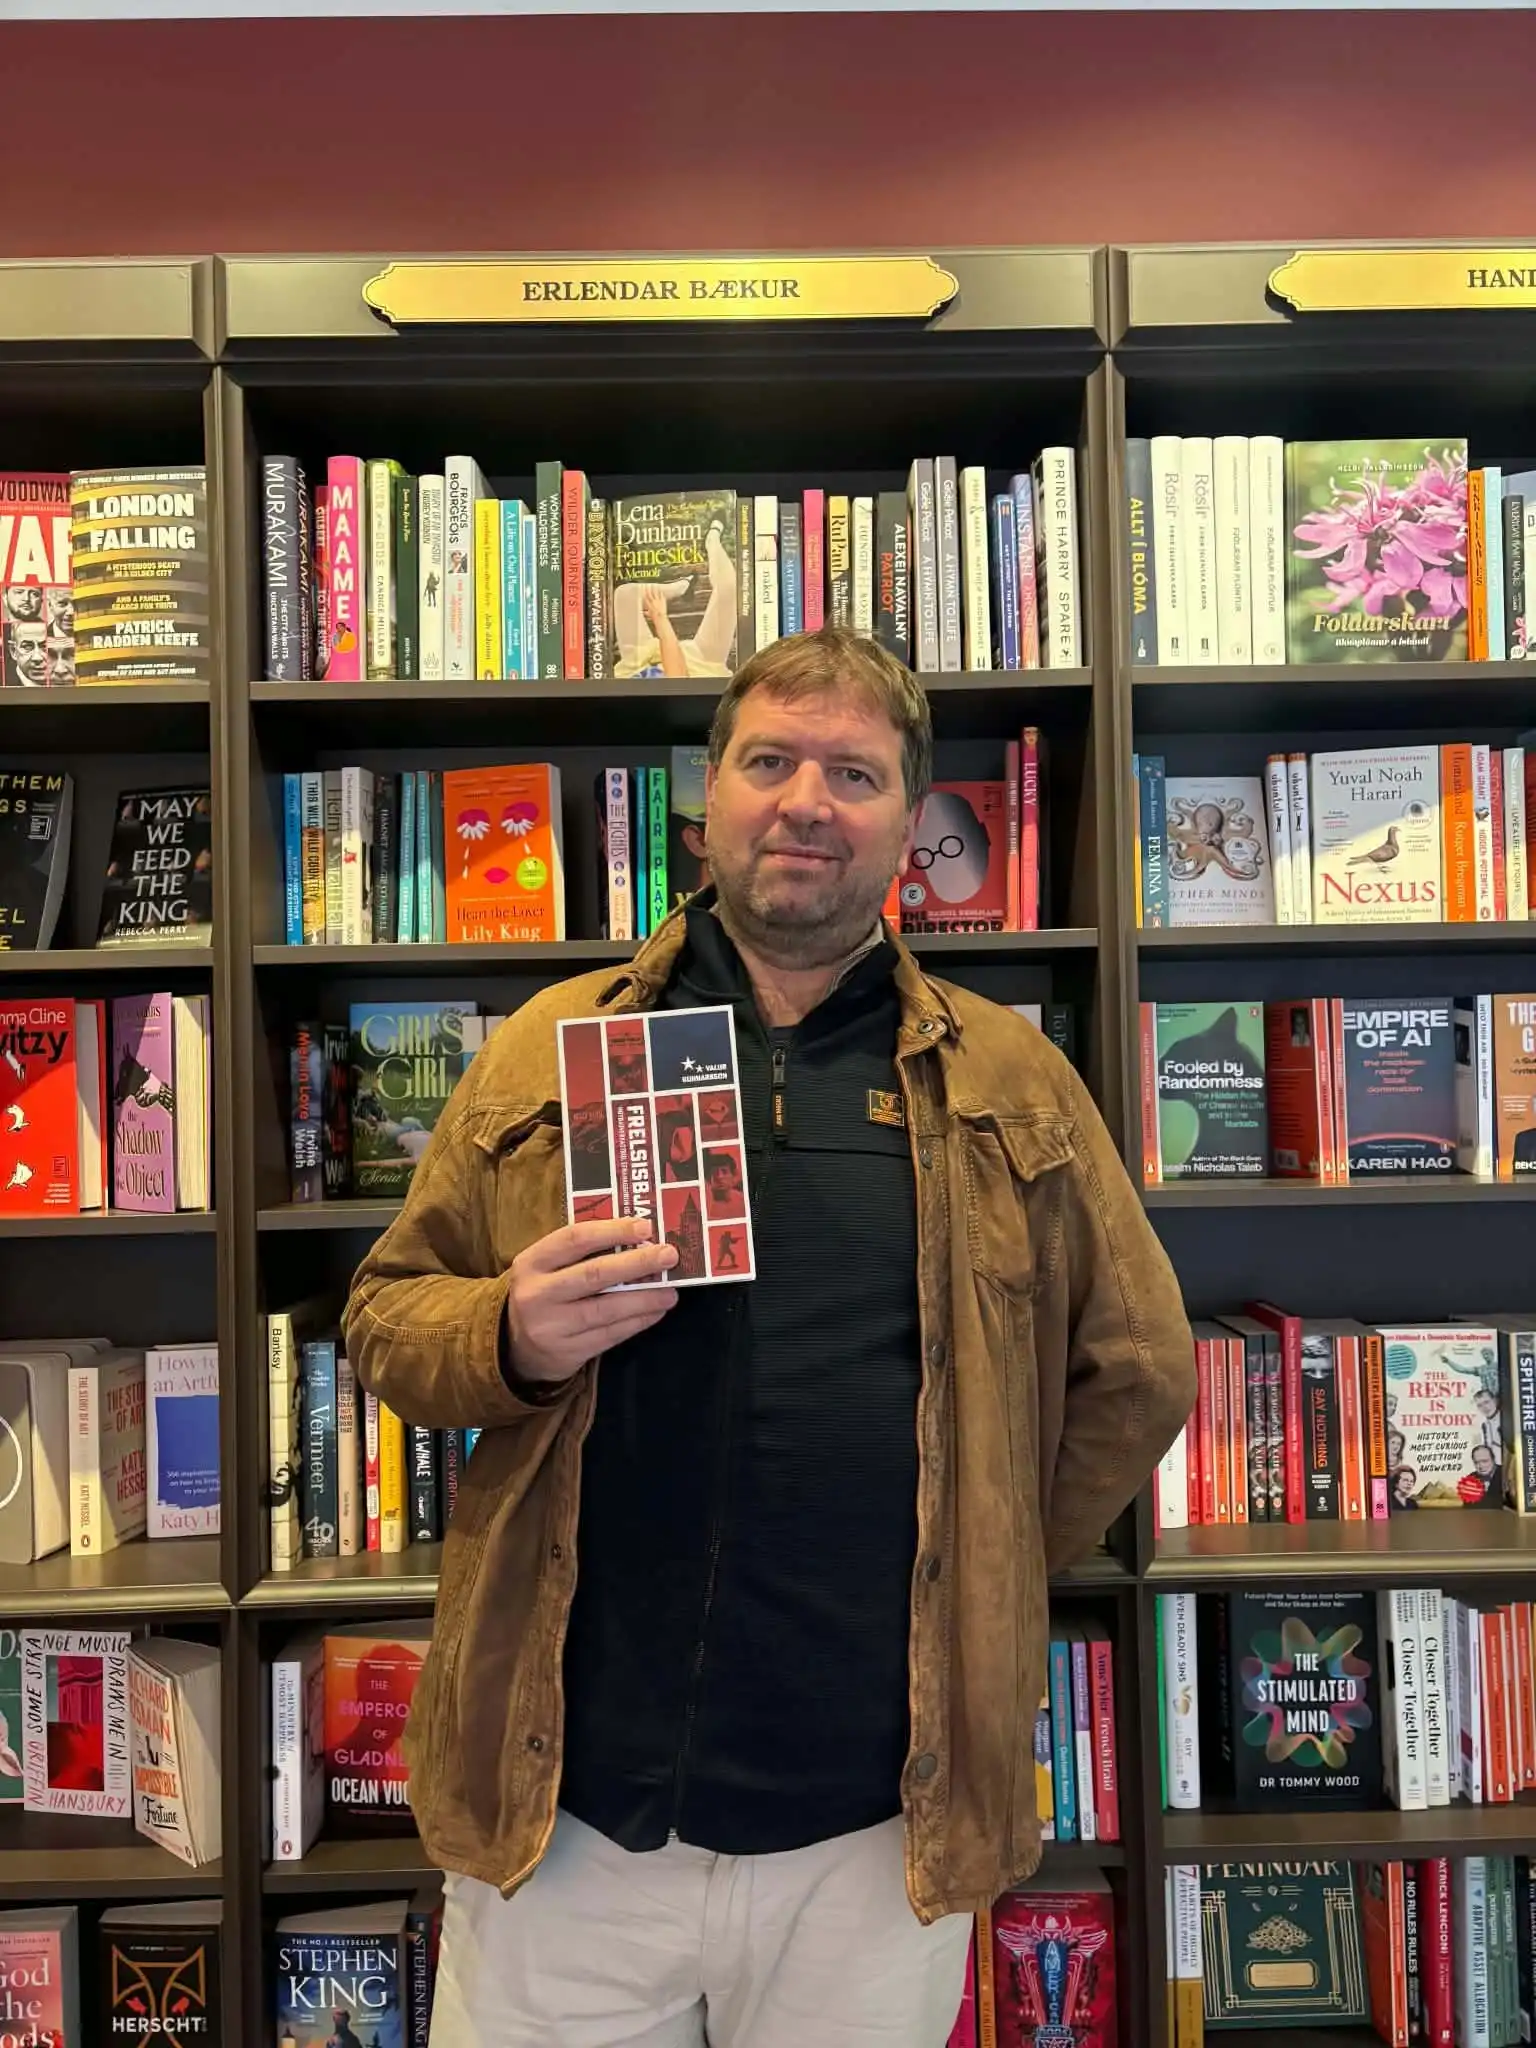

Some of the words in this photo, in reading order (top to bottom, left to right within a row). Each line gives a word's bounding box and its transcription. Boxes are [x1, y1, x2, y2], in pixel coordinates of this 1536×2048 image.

[522, 281, 678, 302] ERLENDAR
[689, 279, 800, 299] BÆKUR
[1055, 459, 1066, 520] PRINCE
[1165, 472, 1179, 518] Rósir
[1195, 474, 1209, 519] Rósir
[89, 494, 194, 520] LONDON
[449, 473, 459, 544] BOURGEOIS
[459, 487, 468, 529] FRANCIS
[550, 494, 559, 534] WOMAN
[568, 488, 578, 537] WILDER
[616, 501, 665, 524] Lena
[1130, 497, 1144, 537] ALLT
[266, 463, 287, 587] MURAKAMI
[298, 467, 310, 593] MURAKAMI
[506, 521, 516, 540] Life
[539, 500, 548, 566] WILDERNESS
[616, 521, 704, 545] Dunham
[89, 526, 196, 552] FALLING
[551, 537, 559, 548] IN
[588, 512, 604, 581] BRYSON
[894, 523, 906, 573] ALEXEI
[333, 486, 353, 619] MAAME
[551, 551, 560, 571] THE
[616, 543, 705, 567] Famesick
[922, 555, 931, 564] A
[945, 553, 953, 562] A
[1057, 526, 1069, 581] HARRY
[568, 542, 578, 607] JOURNEYS
[763, 571, 772, 604] naked
[881, 552, 894, 614] PATRIOT
[922, 566, 934, 598] HYMN
[945, 564, 955, 598] HYMN
[1132, 553, 1149, 614] BLÓMA
[592, 599, 602, 632] WALK
[895, 575, 907, 641] NAVALNY
[923, 600, 934, 617] TO
[946, 600, 955, 617] TO
[1059, 592, 1071, 643] SPARE
[115, 619, 176, 634] PATRICK
[924, 621, 936, 643] LIFE
[947, 619, 956, 643] LIFE
[1313, 613, 1450, 633] Foldarskart
[93, 633, 152, 649] RADDEN
[154, 632, 199, 647] KEEFE
[1476, 751, 1484, 772] ADAM
[1024, 762, 1036, 806] LUCKY
[1329, 766, 1372, 785] Yuval
[1379, 765, 1422, 782] Noah
[1476, 775, 1485, 800] GRANT
[307, 781, 319, 802] THIS
[1351, 787, 1402, 801] Harari
[139, 798, 199, 820] MAY
[653, 772, 663, 838] FAIR
[146, 822, 185, 845] WE
[1455, 821, 1467, 858] Rutger
[132, 848, 191, 871] FEED
[1148, 835, 1162, 895] FEMINA
[134, 874, 184, 896] THE
[653, 856, 664, 921] PLAY
[1321, 872, 1436, 905] Nexus
[1456, 860, 1468, 908] Bregman
[119, 900, 189, 924] KING
[457, 906, 488, 922] Heart
[492, 906, 509, 919] the
[461, 926, 493, 942] Lily
[500, 924, 542, 942] King
[29, 1008, 67, 1025] Cline
[1344, 1010, 1449, 1030] EMPIRE
[297, 1031, 311, 1064] Men
[361, 1012, 465, 1058] GIRL'S
[1356, 1030, 1397, 1048] OF
[1402, 1029, 1431, 1047] AI
[299, 1066, 311, 1082] in
[377, 1057, 453, 1100] GIRL
[1164, 1061, 1219, 1074] Fooled
[1223, 1061, 1244, 1076] by
[1159, 1075, 1264, 1090] Randomness
[299, 1086, 312, 1120] Love
[116, 1118, 164, 1156] Shadow
[295, 1128, 306, 1168] Welsh
[306, 1129, 318, 1167] Irvine
[627, 1105, 652, 1219] FRELSISBJA
[1194, 1162, 1236, 1172] Nicholas
[1237, 1162, 1263, 1172] Taleb
[1412, 1157, 1452, 1168] HAO
[125, 1165, 166, 1202] Object
[271, 1328, 282, 1369] Banksy
[158, 1356, 197, 1372] How
[1424, 1371, 1448, 1381] THE
[154, 1380, 176, 1393] an
[1315, 1388, 1326, 1410] SAY
[1409, 1382, 1467, 1399] REST
[1520, 1357, 1536, 1431] SPITFIRE
[107, 1390, 125, 1414] THE
[1430, 1400, 1446, 1411] IS
[116, 1410, 128, 1433] OF
[1402, 1414, 1477, 1428] HISTORY
[309, 1405, 330, 1495] Vermeer
[1316, 1413, 1328, 1468] NOTHING
[416, 1442, 431, 1478] WHALE
[161, 1513, 199, 1532] Katy
[1176, 1595, 1185, 1620] EVEN
[78, 1636, 128, 1652] MUSIC
[1176, 1622, 1186, 1659] DEADLY
[1177, 1661, 1187, 1682] SINS
[1295, 1653, 1319, 1672] THE
[1400, 1638, 1415, 1688] Closer
[1424, 1636, 1438, 1685] Closer
[107, 1656, 127, 1712] DRAWS
[370, 1680, 388, 1691] THE
[1257, 1680, 1357, 1702] STIMULATED
[28, 1685, 43, 1734] SOME
[339, 1702, 410, 1718] EMPERO
[1286, 1710, 1330, 1733] MIND
[108, 1716, 126, 1740] ME
[373, 1729, 388, 1740] OF
[1402, 1690, 1420, 1761] Together
[1424, 1688, 1442, 1758] Together
[1100, 1717, 1111, 1756] French
[107, 1743, 127, 1760] IN
[28, 1741, 45, 1806] GRIFFIN
[1102, 1759, 1113, 1791] Braid
[1259, 1777, 1276, 1788] DR
[1280, 1777, 1321, 1787] TOMMY
[1325, 1776, 1360, 1786] WOOD
[49, 1792, 126, 1815] HANSBURY
[331, 1777, 379, 1804] OCEAN
[1178, 1866, 1198, 1880] 7
[1406, 1881, 1416, 1898] NO
[1406, 1900, 1417, 1936] RULES
[1439, 1902, 1449, 1954] LENCIONI
[1472, 1905, 1484, 1946] ADAPTIVE
[279, 1948, 397, 1972] STEPHEN
[1407, 1937, 1418, 1973] RULES
[1473, 1951, 1485, 1977] ASSET
[413, 1934, 427, 2004] STEPHEN
[289, 1976, 388, 2009] KING
[1474, 1982, 1486, 2034] ALLOCATION
[112, 2016, 201, 2033] HERSCHT
[415, 2006, 428, 2043] KING
